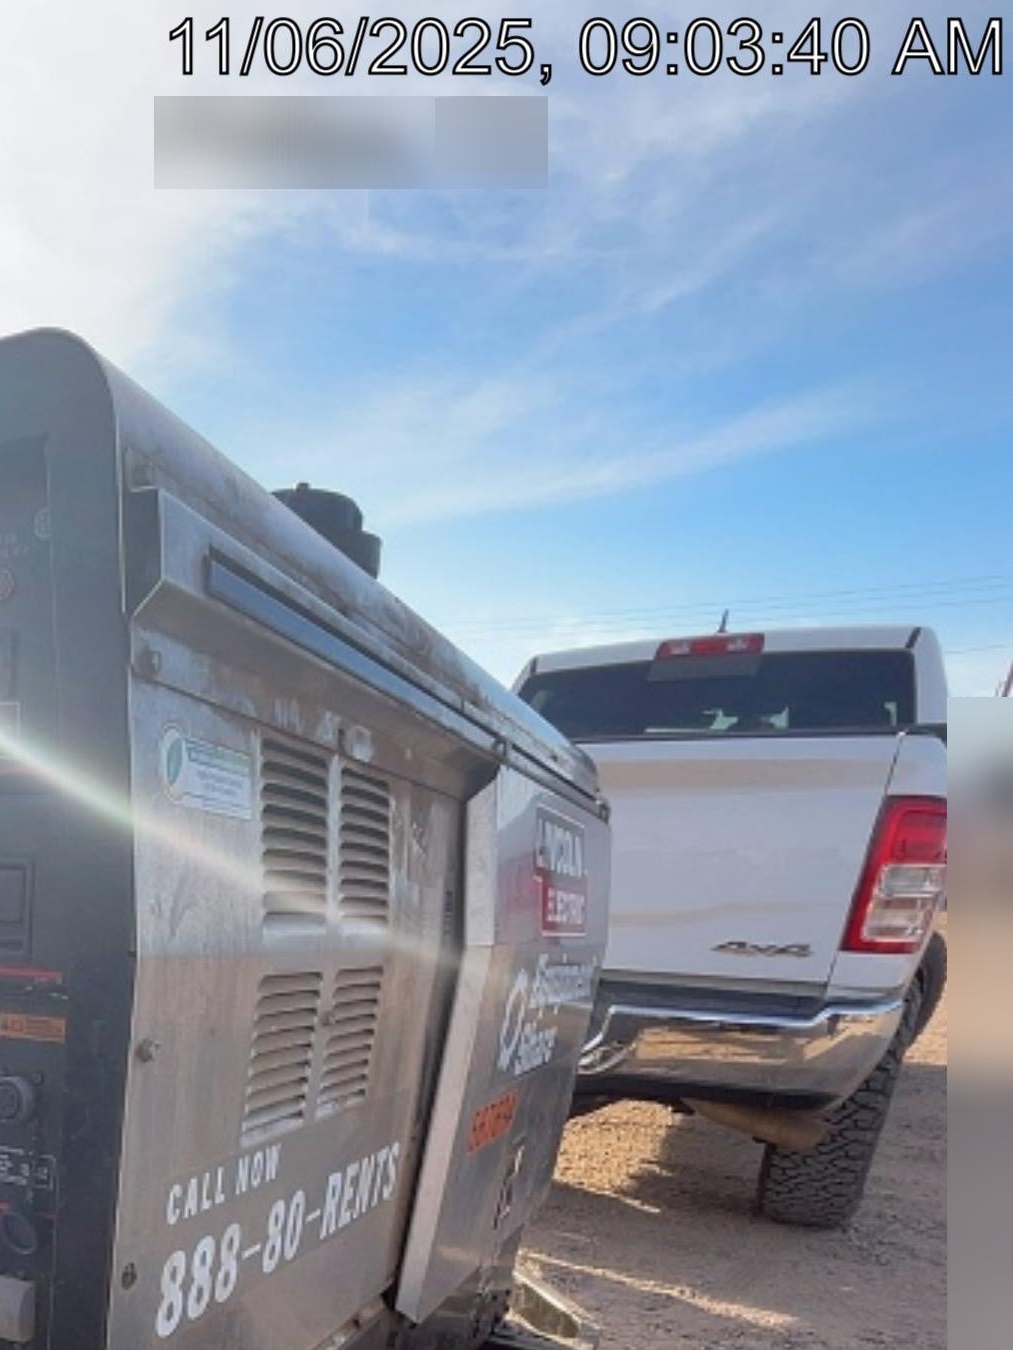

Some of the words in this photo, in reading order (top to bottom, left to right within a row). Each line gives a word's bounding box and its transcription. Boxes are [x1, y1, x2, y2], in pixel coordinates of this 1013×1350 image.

[155, 1141, 400, 1338] 888-80-RENTS
[166, 1166, 226, 1225] CALL
[235, 1143, 282, 1195] NOW
